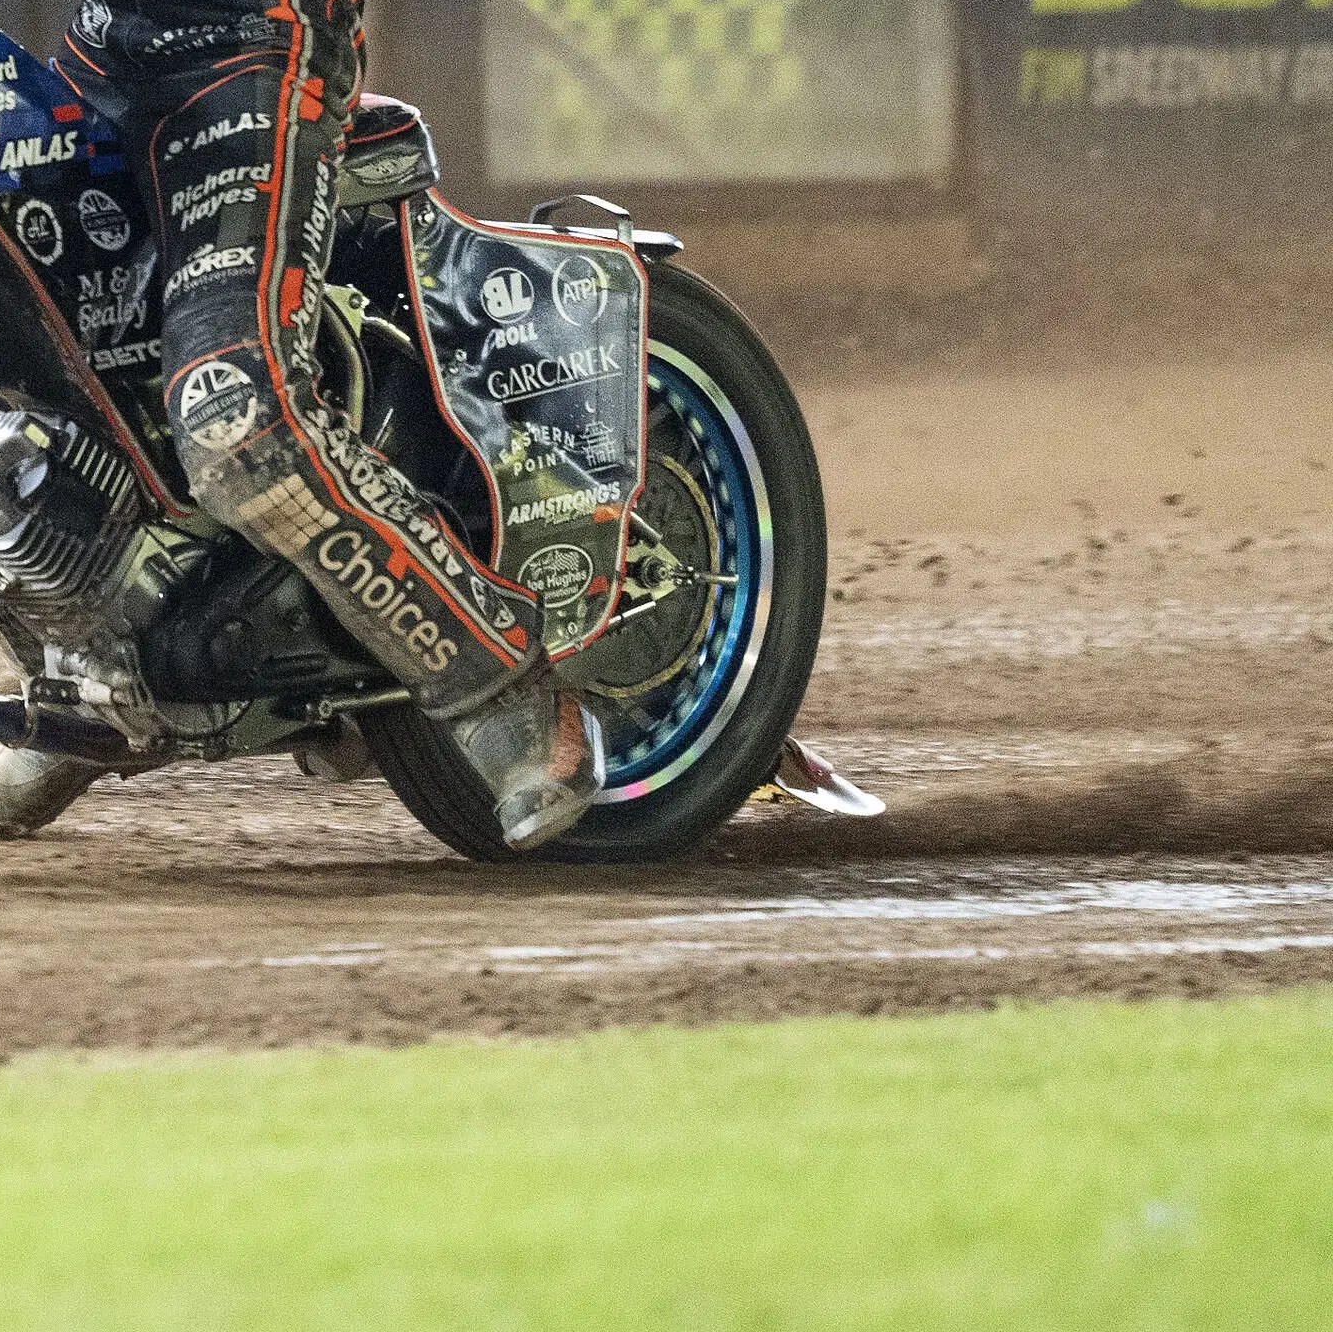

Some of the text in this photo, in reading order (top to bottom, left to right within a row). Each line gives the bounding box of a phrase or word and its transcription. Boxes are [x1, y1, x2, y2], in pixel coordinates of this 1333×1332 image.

[0, 130, 78, 170] ANLAS
[192, 112, 272, 150] ANLAS
[171, 163, 272, 217] Richard
[181, 187, 258, 232] Hayes
[495, 322, 538, 350] BOLL
[487, 344, 621, 401] GARCAREK
[500, 422, 576, 465] EASTERN
[514, 447, 568, 476] POINT
[318, 530, 459, 672] Choices
